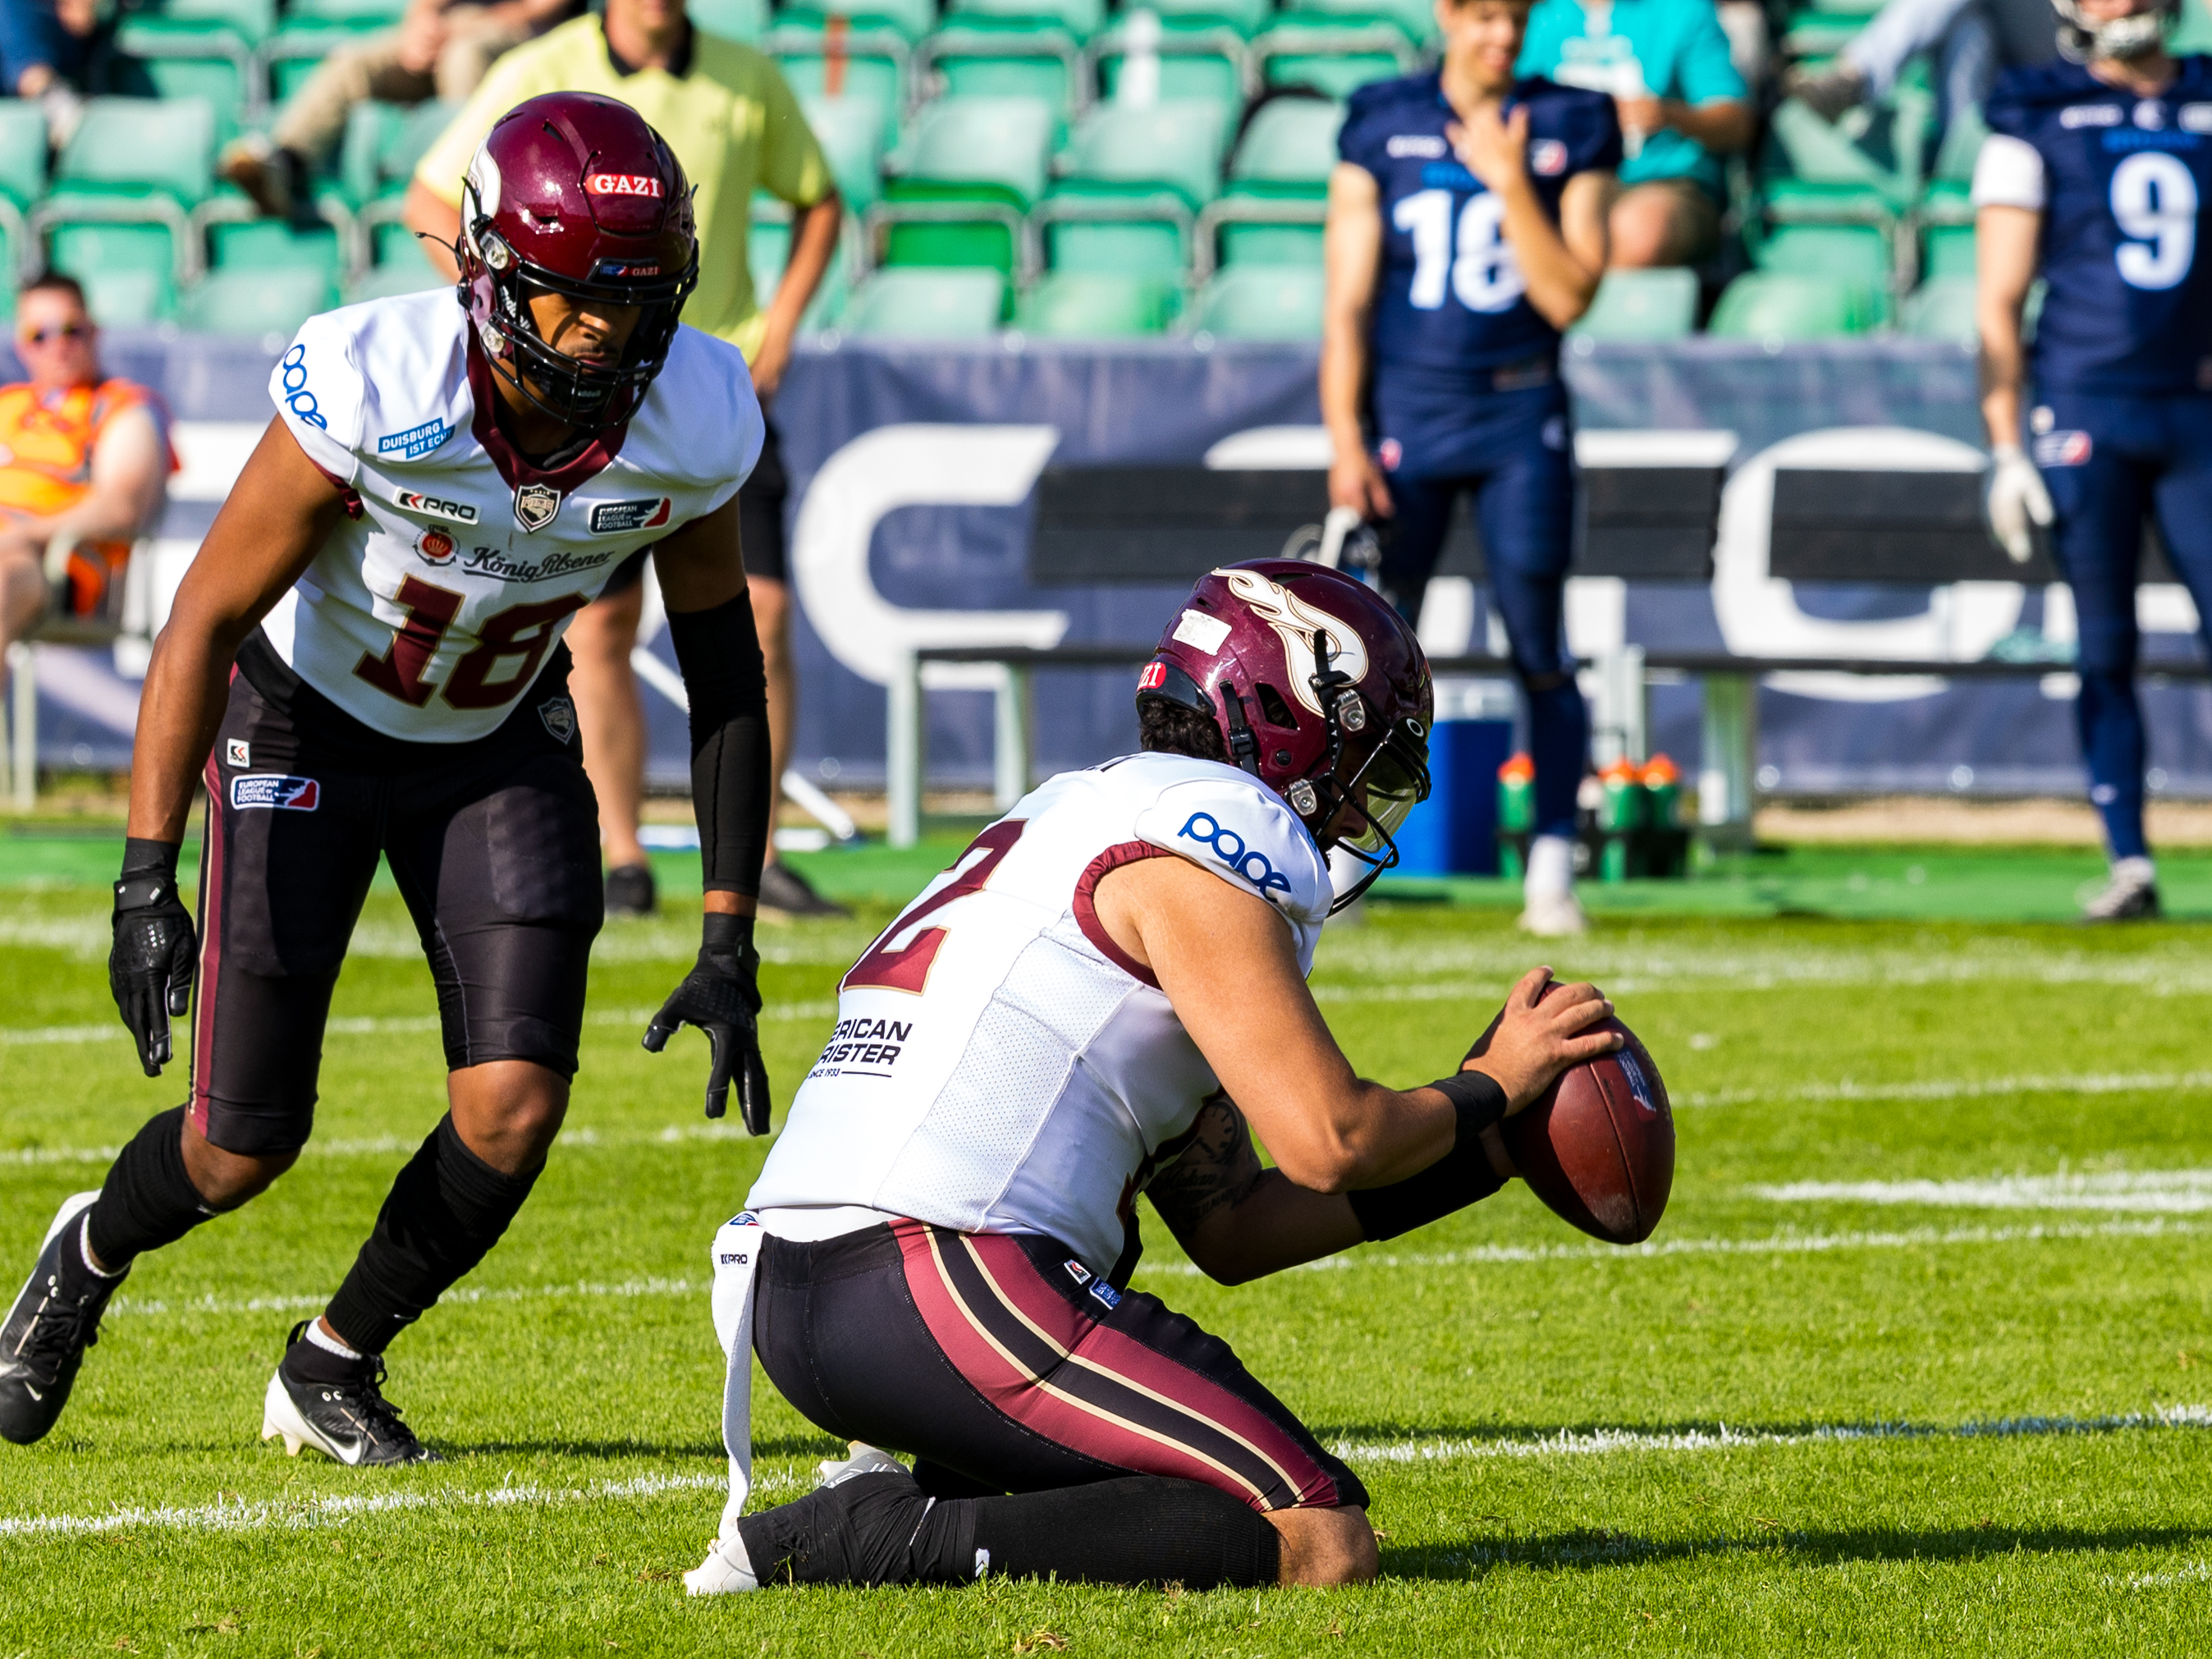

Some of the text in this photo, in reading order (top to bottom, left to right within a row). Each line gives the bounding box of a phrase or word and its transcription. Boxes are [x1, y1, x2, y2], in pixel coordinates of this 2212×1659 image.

[2110, 151, 2199, 290] 9
[382, 422, 441, 451] DUISBURG
[410, 441, 425, 456] IST
[597, 520, 633, 530] FOOTBALL
[464, 546, 538, 584] König
[352, 573, 591, 710] 18
[237, 787, 264, 795] LEAGUE
[238, 780, 279, 789] EUROPEAN
[236, 794, 275, 804] FOOTBALL
[1177, 811, 1292, 904] pape
